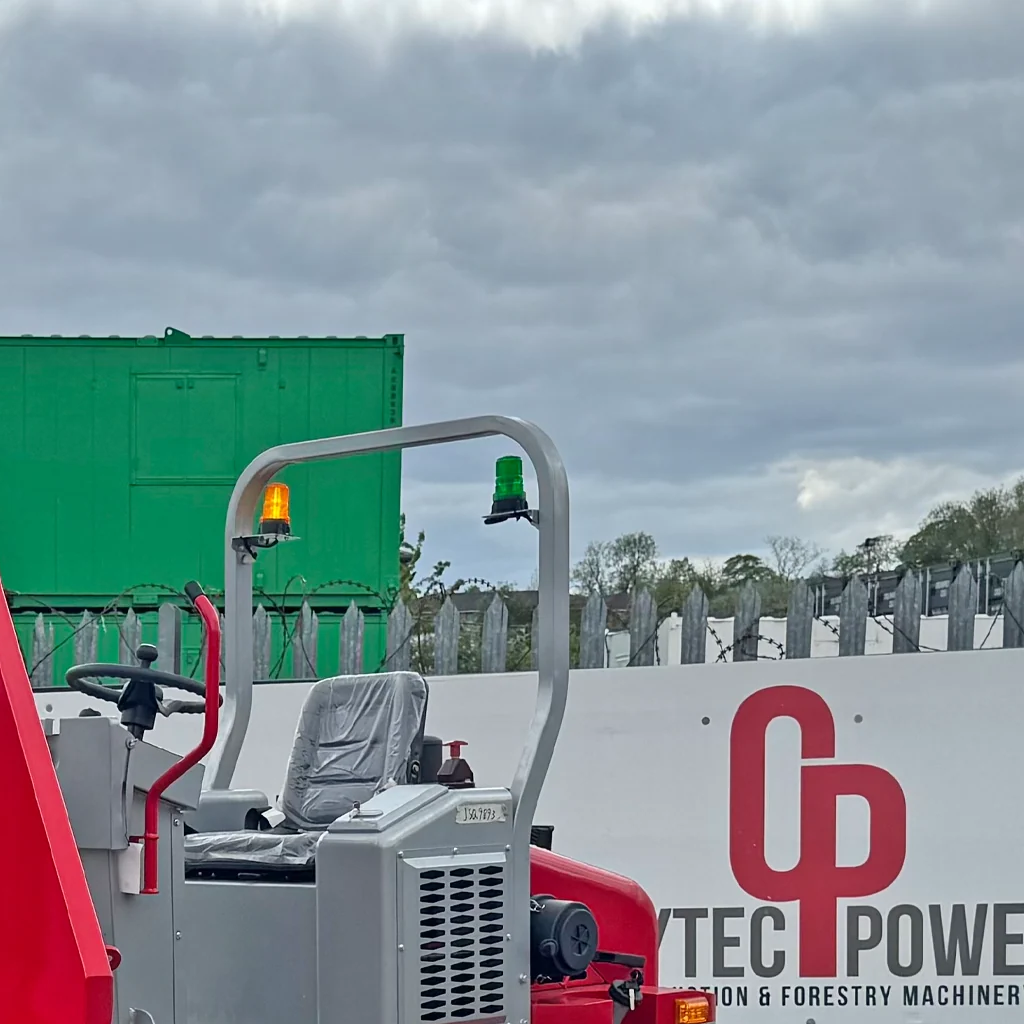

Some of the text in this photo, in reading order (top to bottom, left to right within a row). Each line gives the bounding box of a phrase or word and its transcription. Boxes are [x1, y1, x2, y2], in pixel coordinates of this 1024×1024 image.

[846, 903, 1024, 978] POWE
[759, 986, 771, 1006] &
[782, 985, 891, 1006] FORESTRY
[903, 984, 1024, 1006] MACHINER
